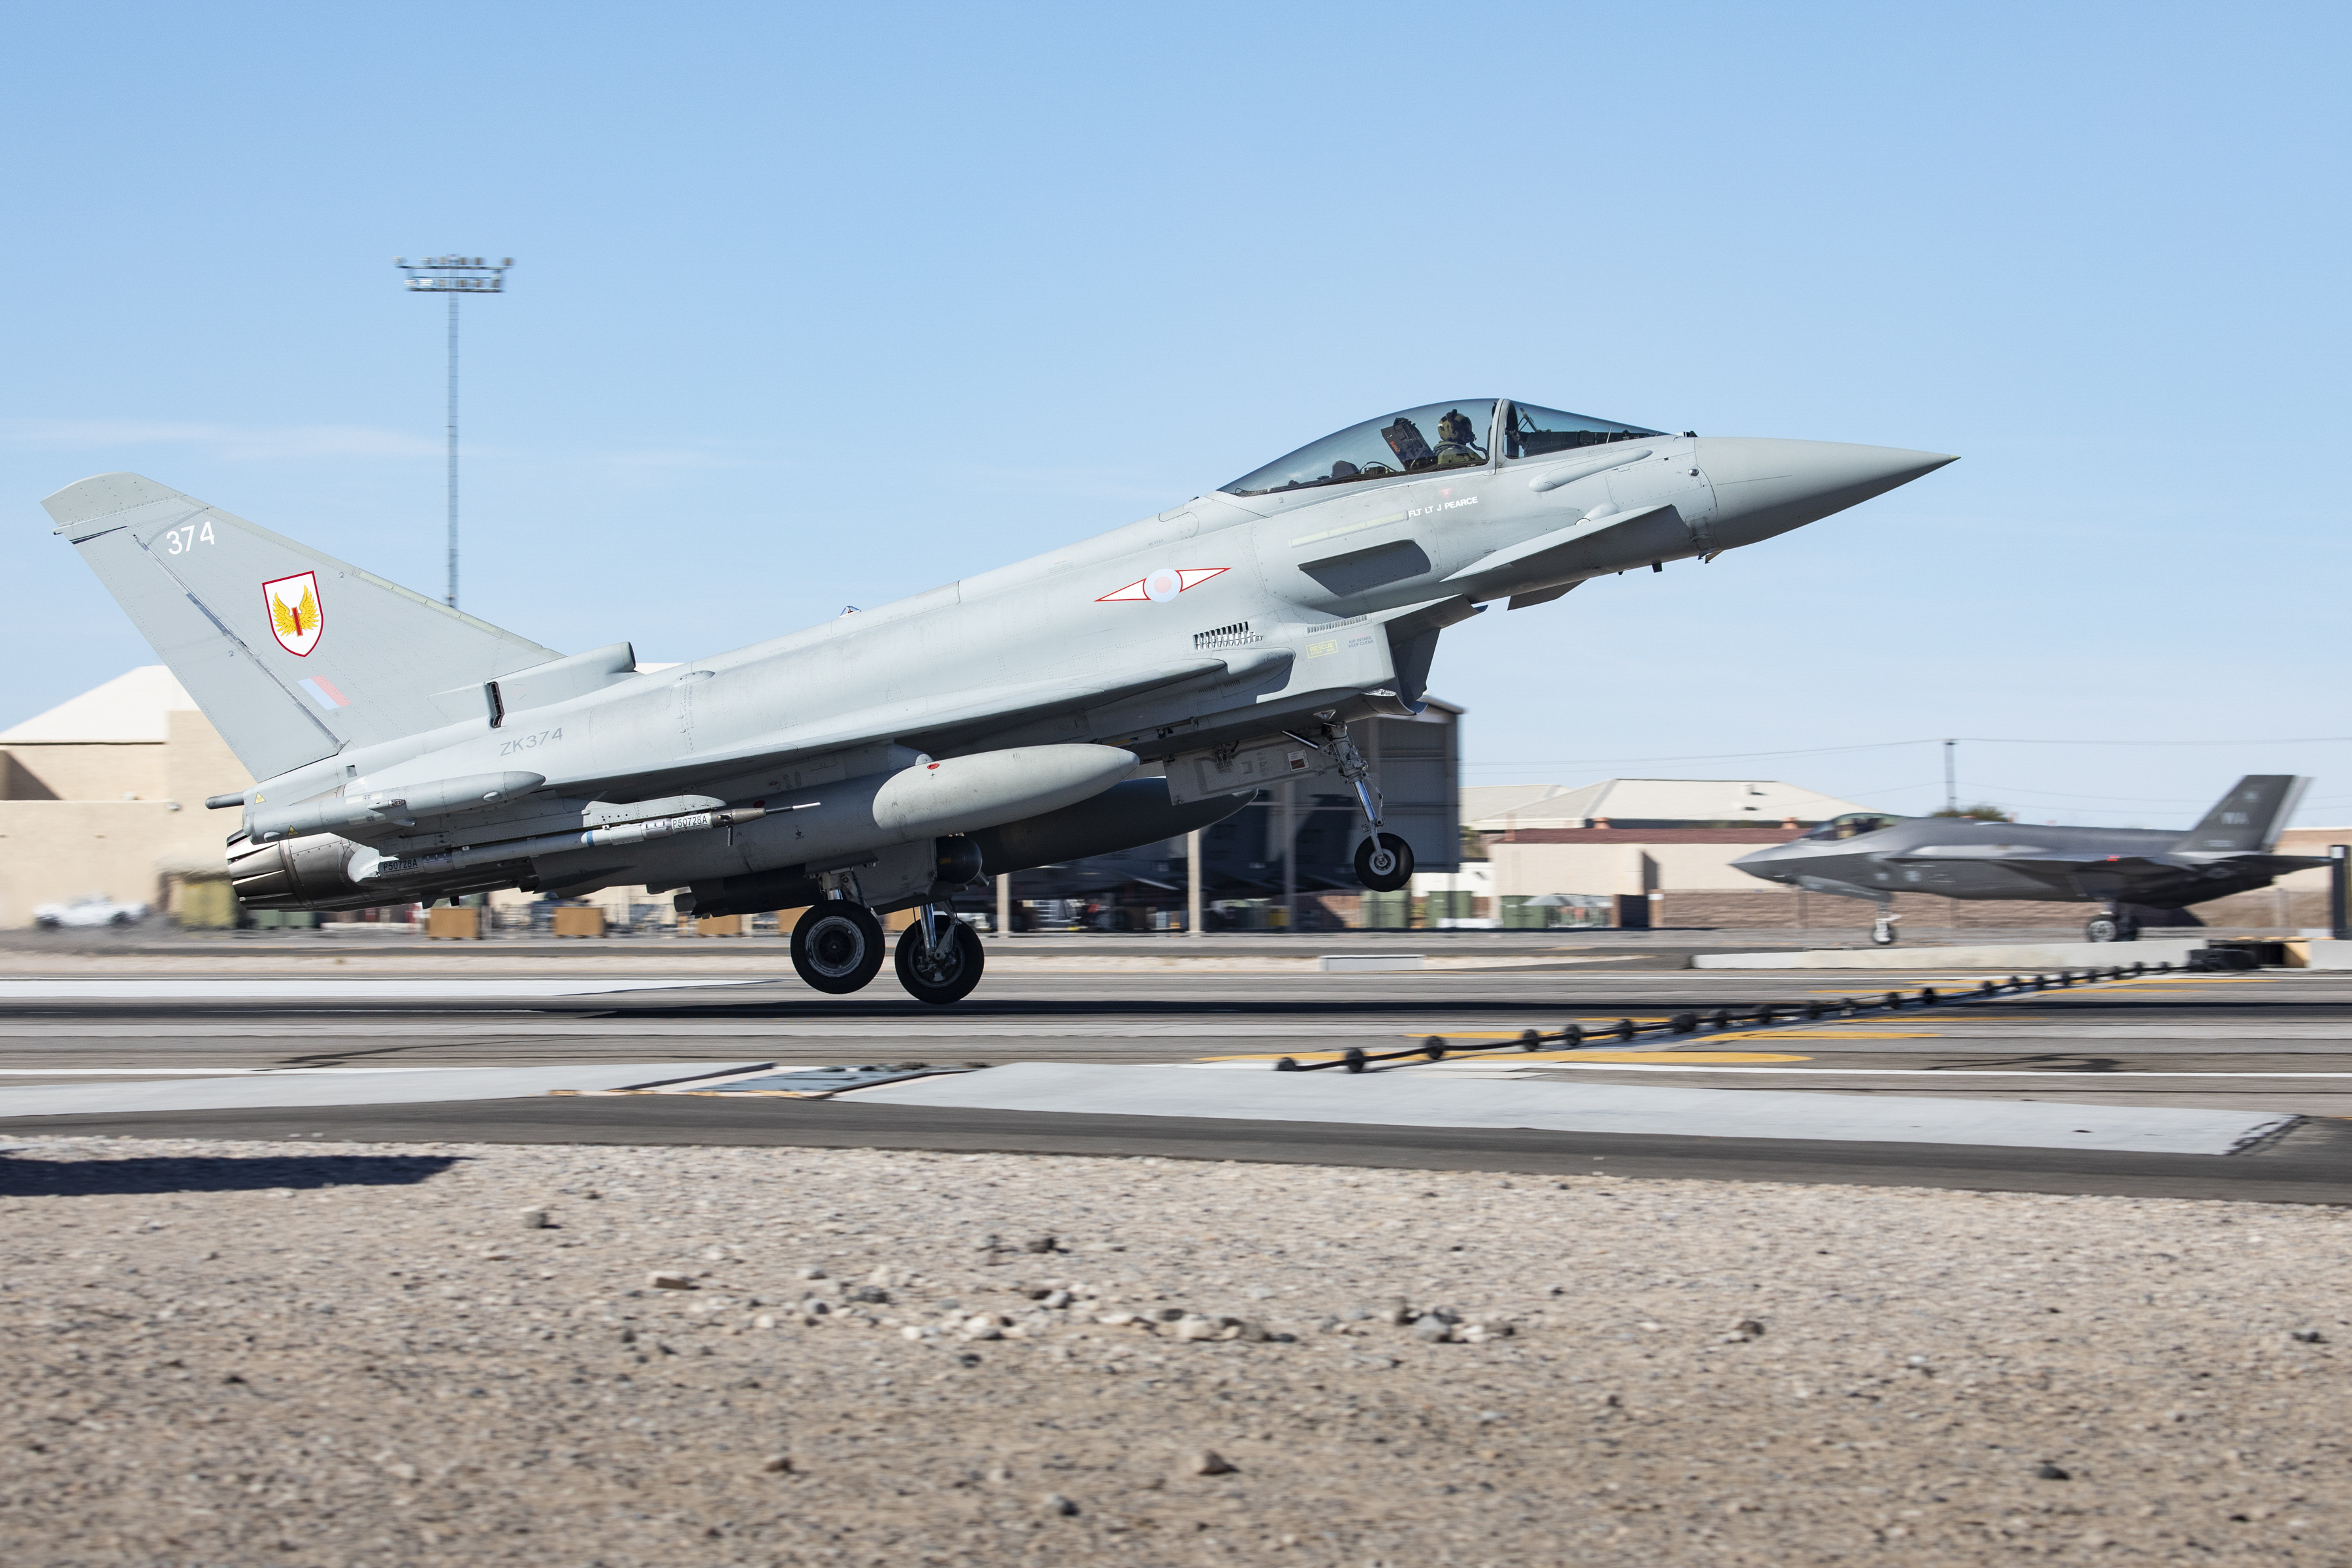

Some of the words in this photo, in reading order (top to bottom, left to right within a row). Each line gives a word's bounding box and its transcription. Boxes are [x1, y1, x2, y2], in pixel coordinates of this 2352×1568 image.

[1408, 508, 1422, 517] FLT
[1424, 506, 1434, 514] LT
[1444, 496, 1478, 510] PEARCE
[166, 521, 215, 555] 374
[1309, 642, 1334, 652] RESCUE
[500, 727, 563, 757] ZK374
[672, 815, 708, 828] P50728A
[383, 858, 418, 871] P50728A
